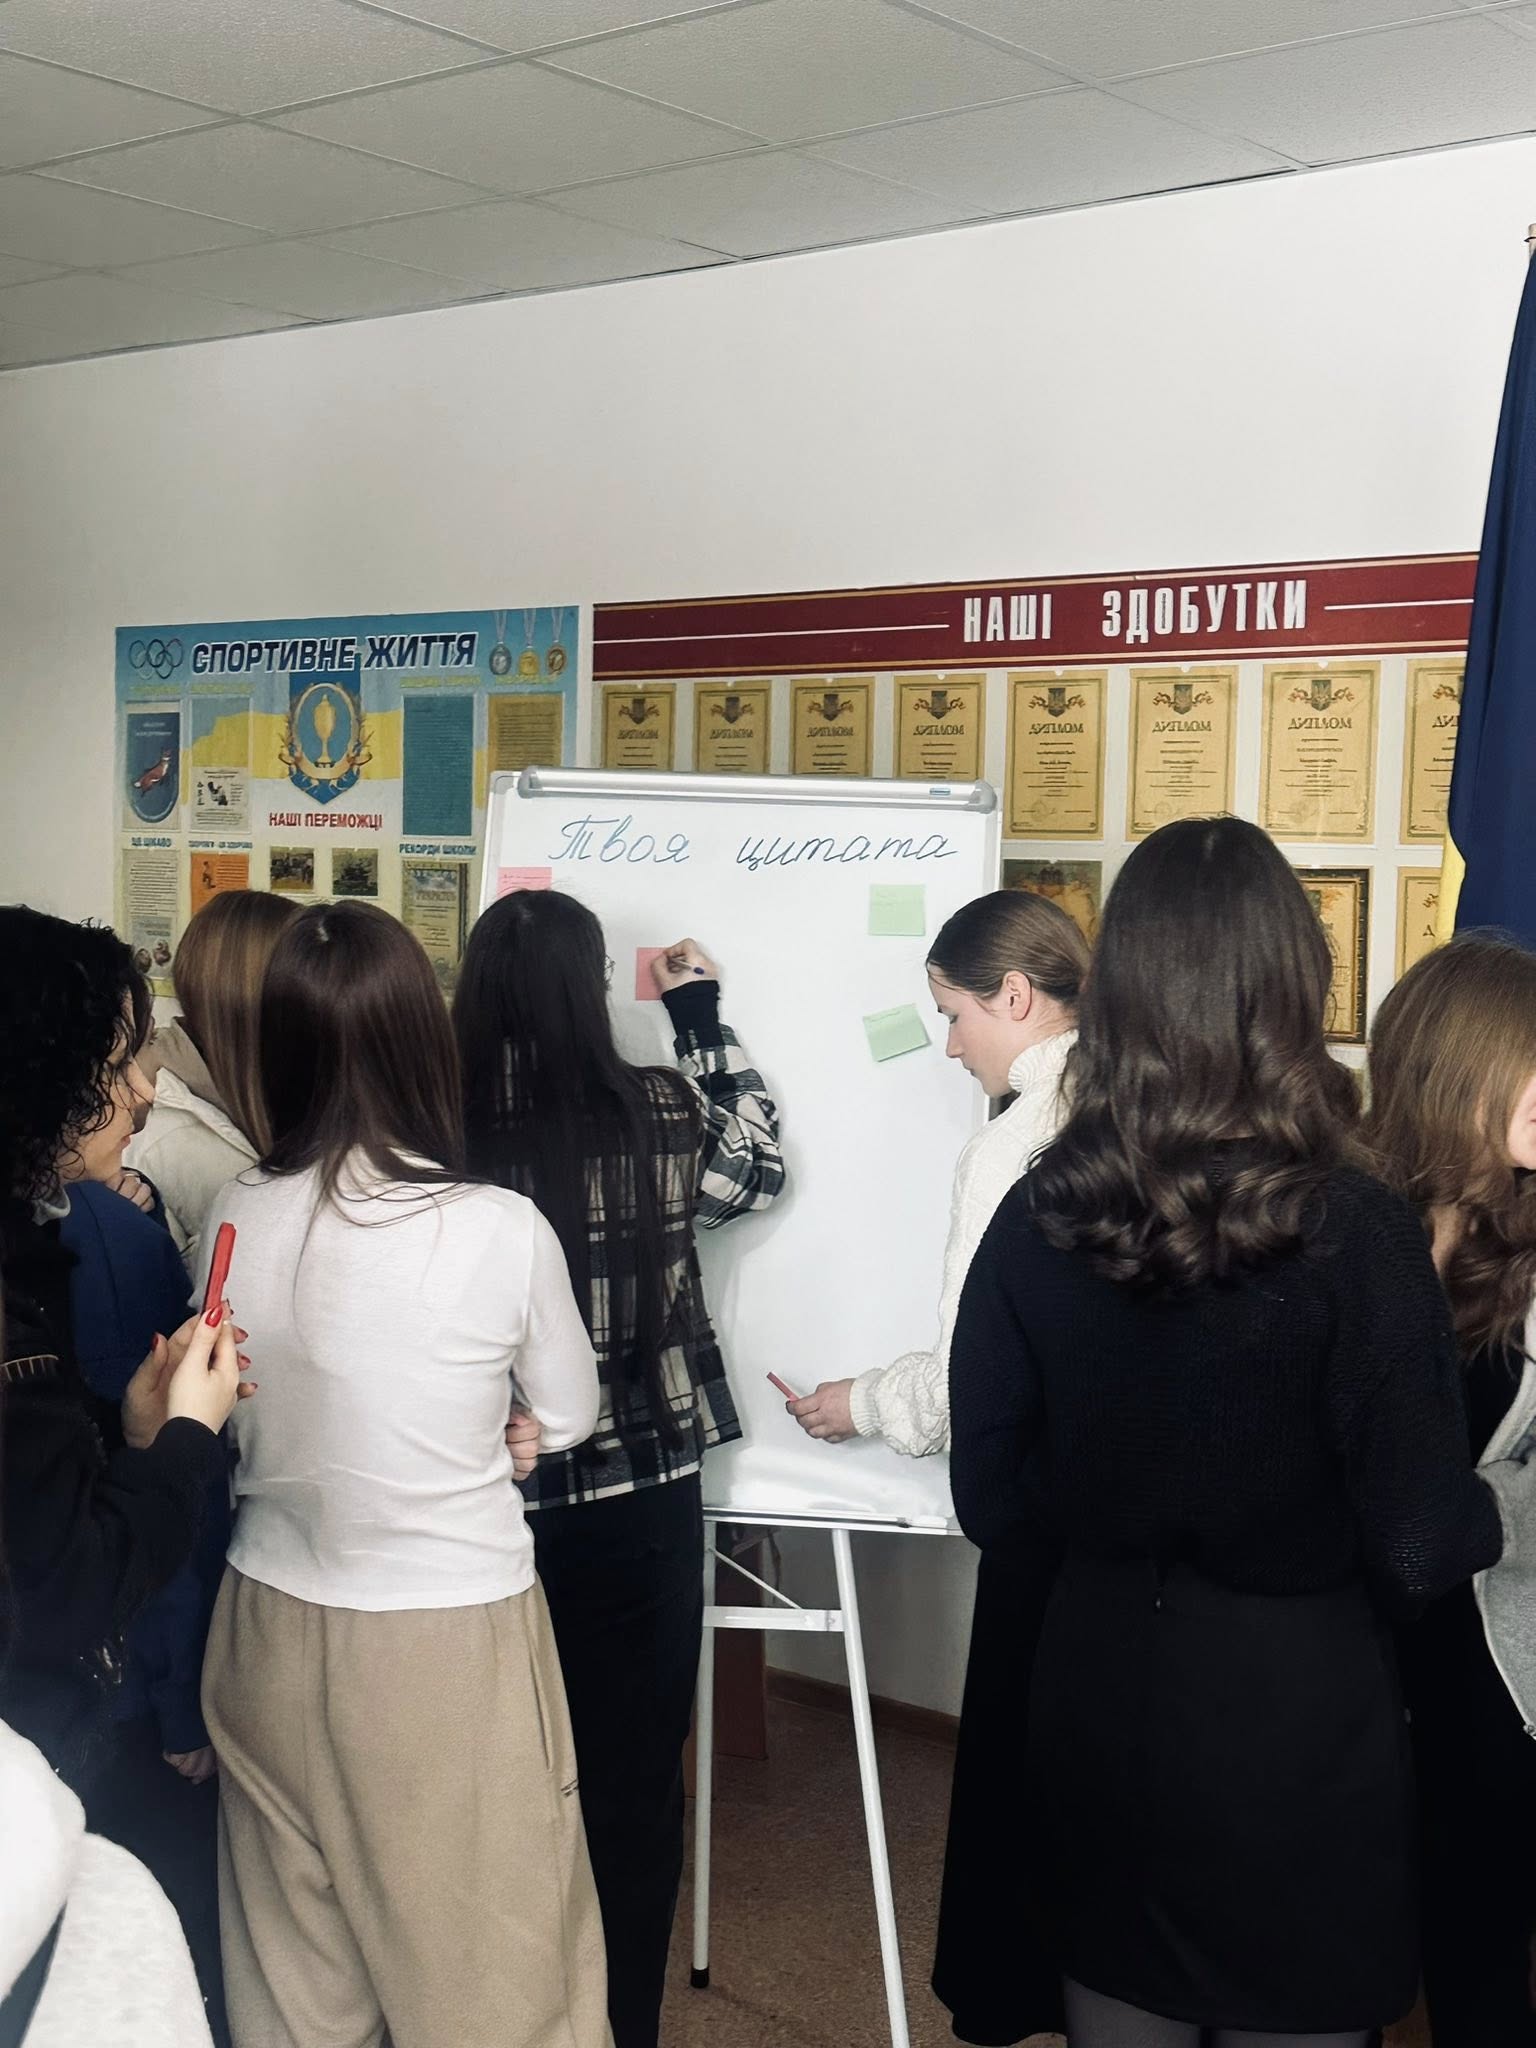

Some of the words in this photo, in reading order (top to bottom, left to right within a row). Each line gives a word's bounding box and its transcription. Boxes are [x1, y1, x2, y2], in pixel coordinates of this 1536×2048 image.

[964, 594, 1052, 643] НАШІ
[1102, 580, 1307, 644] ЗДОБУТКИ
[192, 638, 357, 675] СПОРТИВНЕ
[361, 632, 478, 670] ЖИТТЯ
[1028, 722, 1084, 735] ДИПЛОМ
[1151, 720, 1212, 733] ДИПЛОМ
[1287, 717, 1353, 730] ДИПЛОМ
[269, 812, 301, 828] НАШІ
[304, 812, 383, 831] ПЕРЕМОЖЦІ
[548, 814, 690, 864] Твоя
[735, 834, 958, 871] цитата
